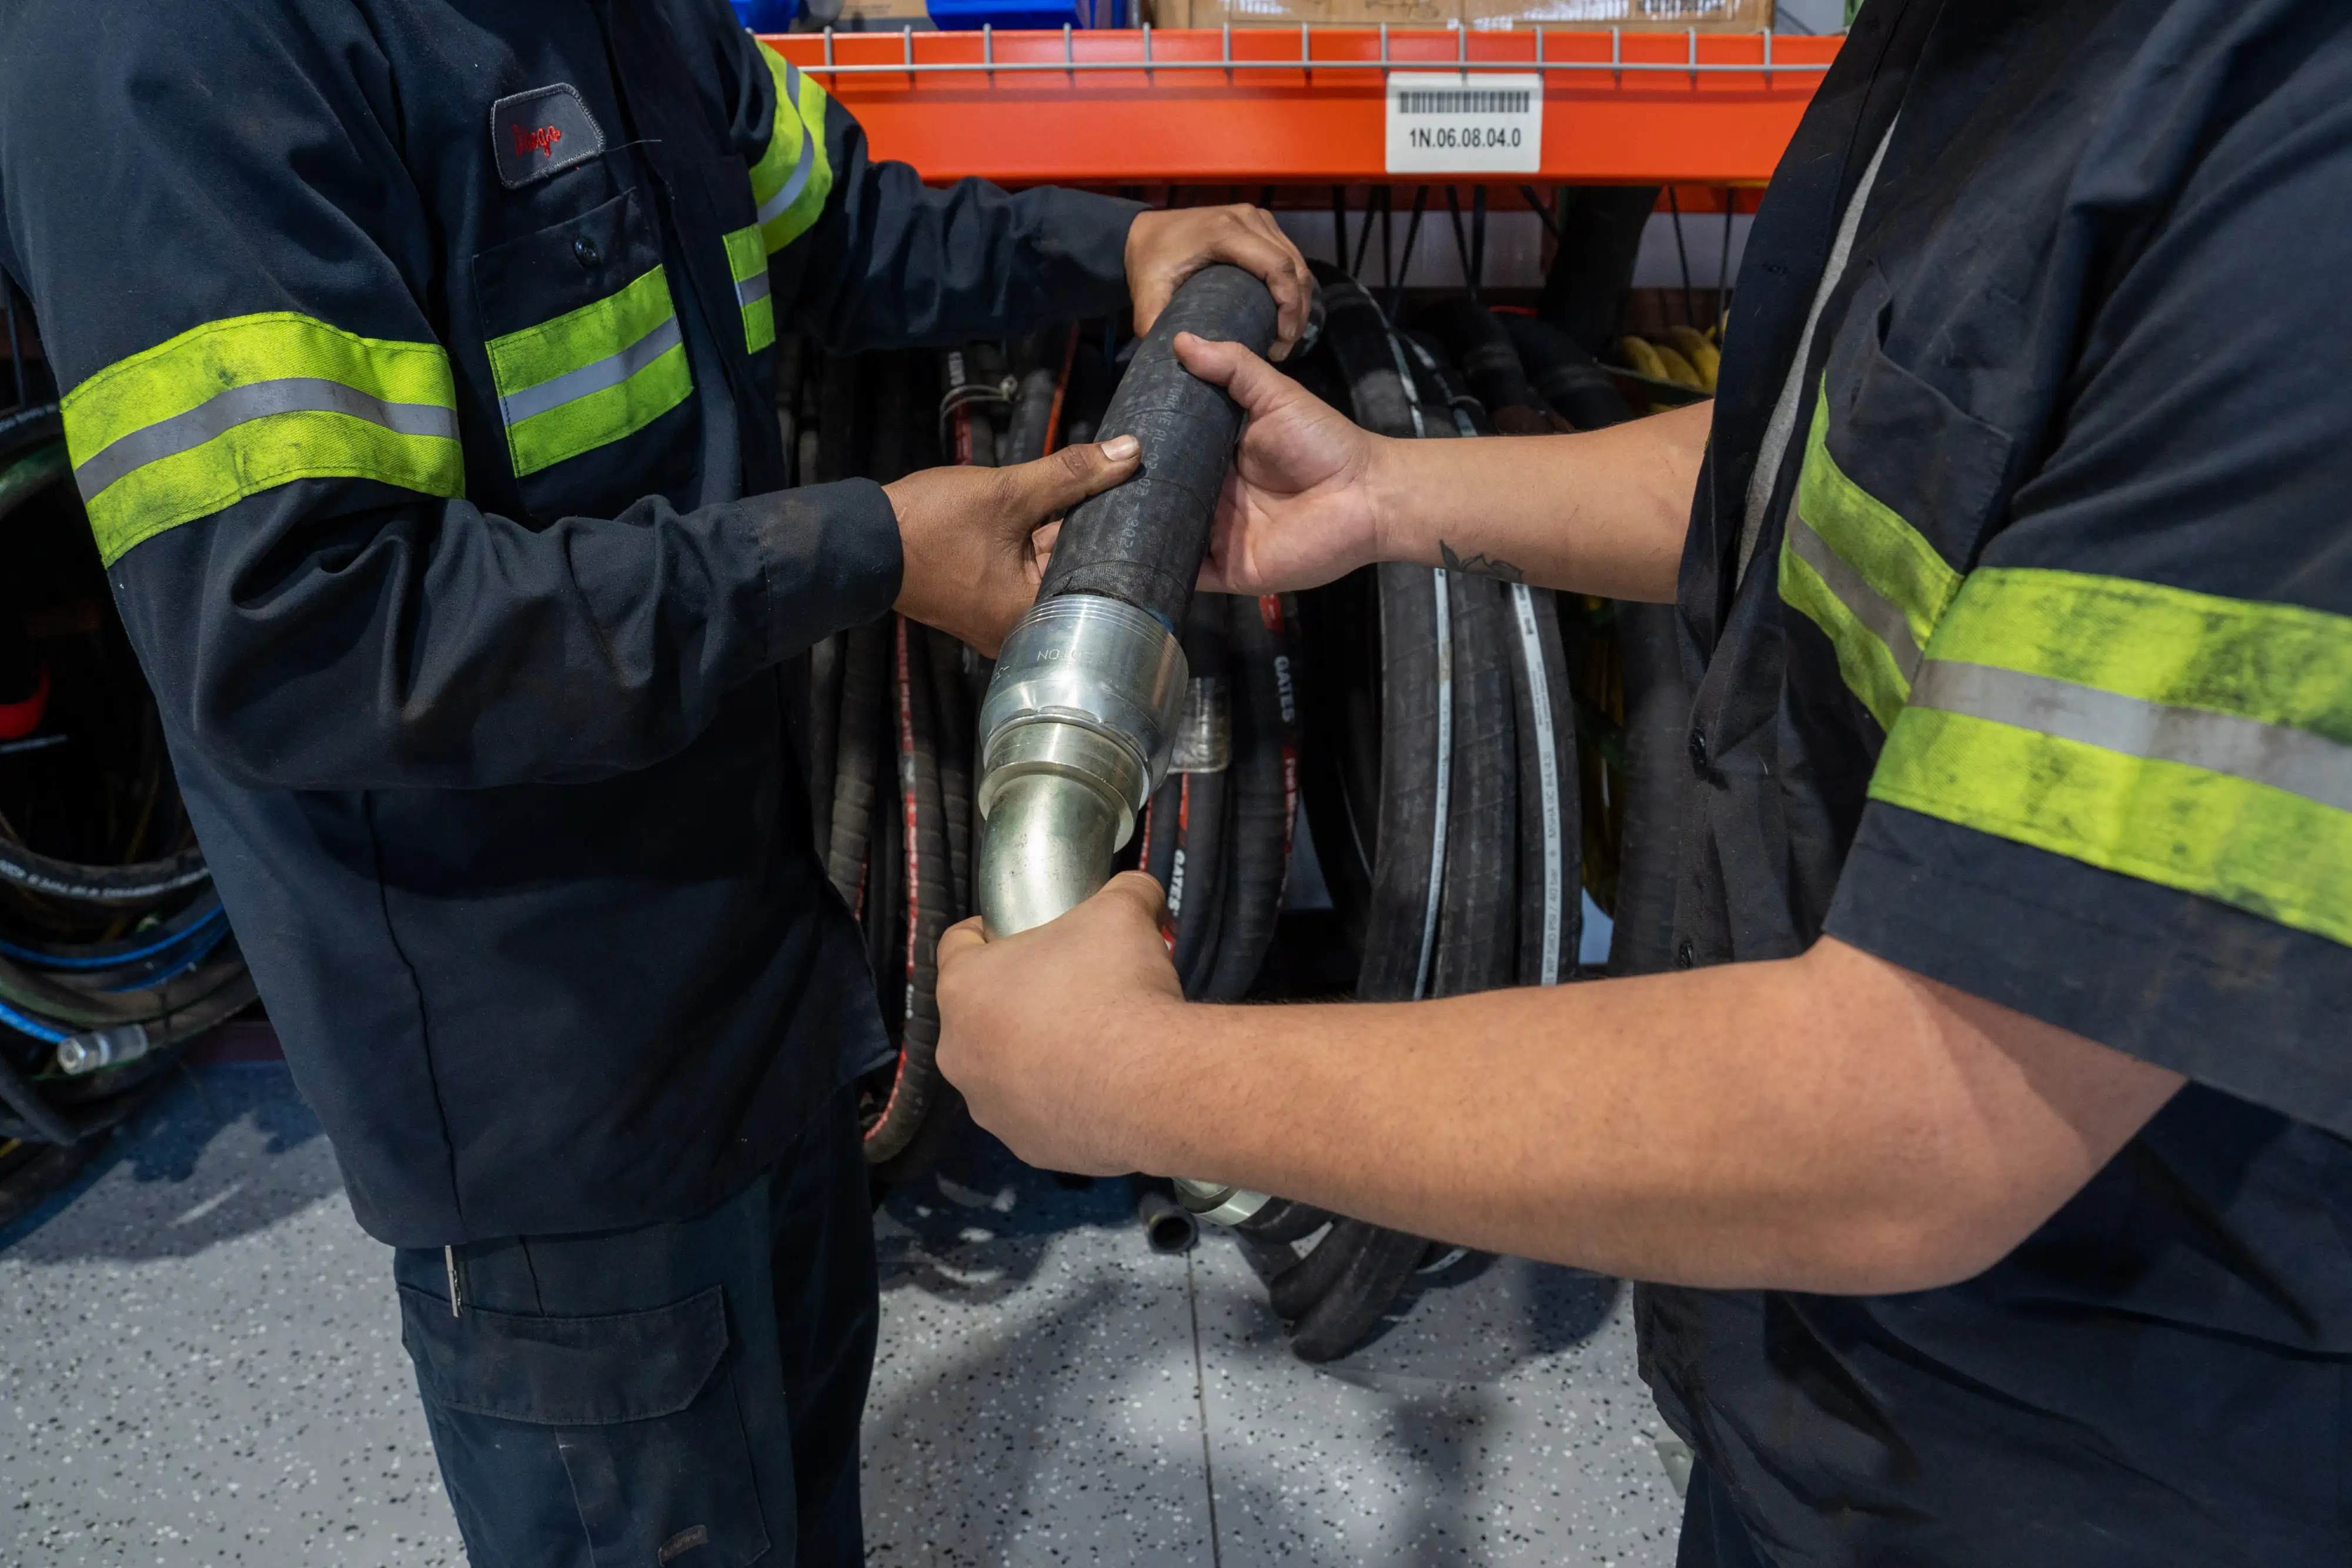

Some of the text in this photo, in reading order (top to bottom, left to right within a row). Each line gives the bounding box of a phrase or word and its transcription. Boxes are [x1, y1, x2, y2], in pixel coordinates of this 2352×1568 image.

[1410, 128, 1521, 147] 1N.06.08.04.0
[1274, 656, 1295, 723] GATES
[1168, 849, 1185, 912] GATES
